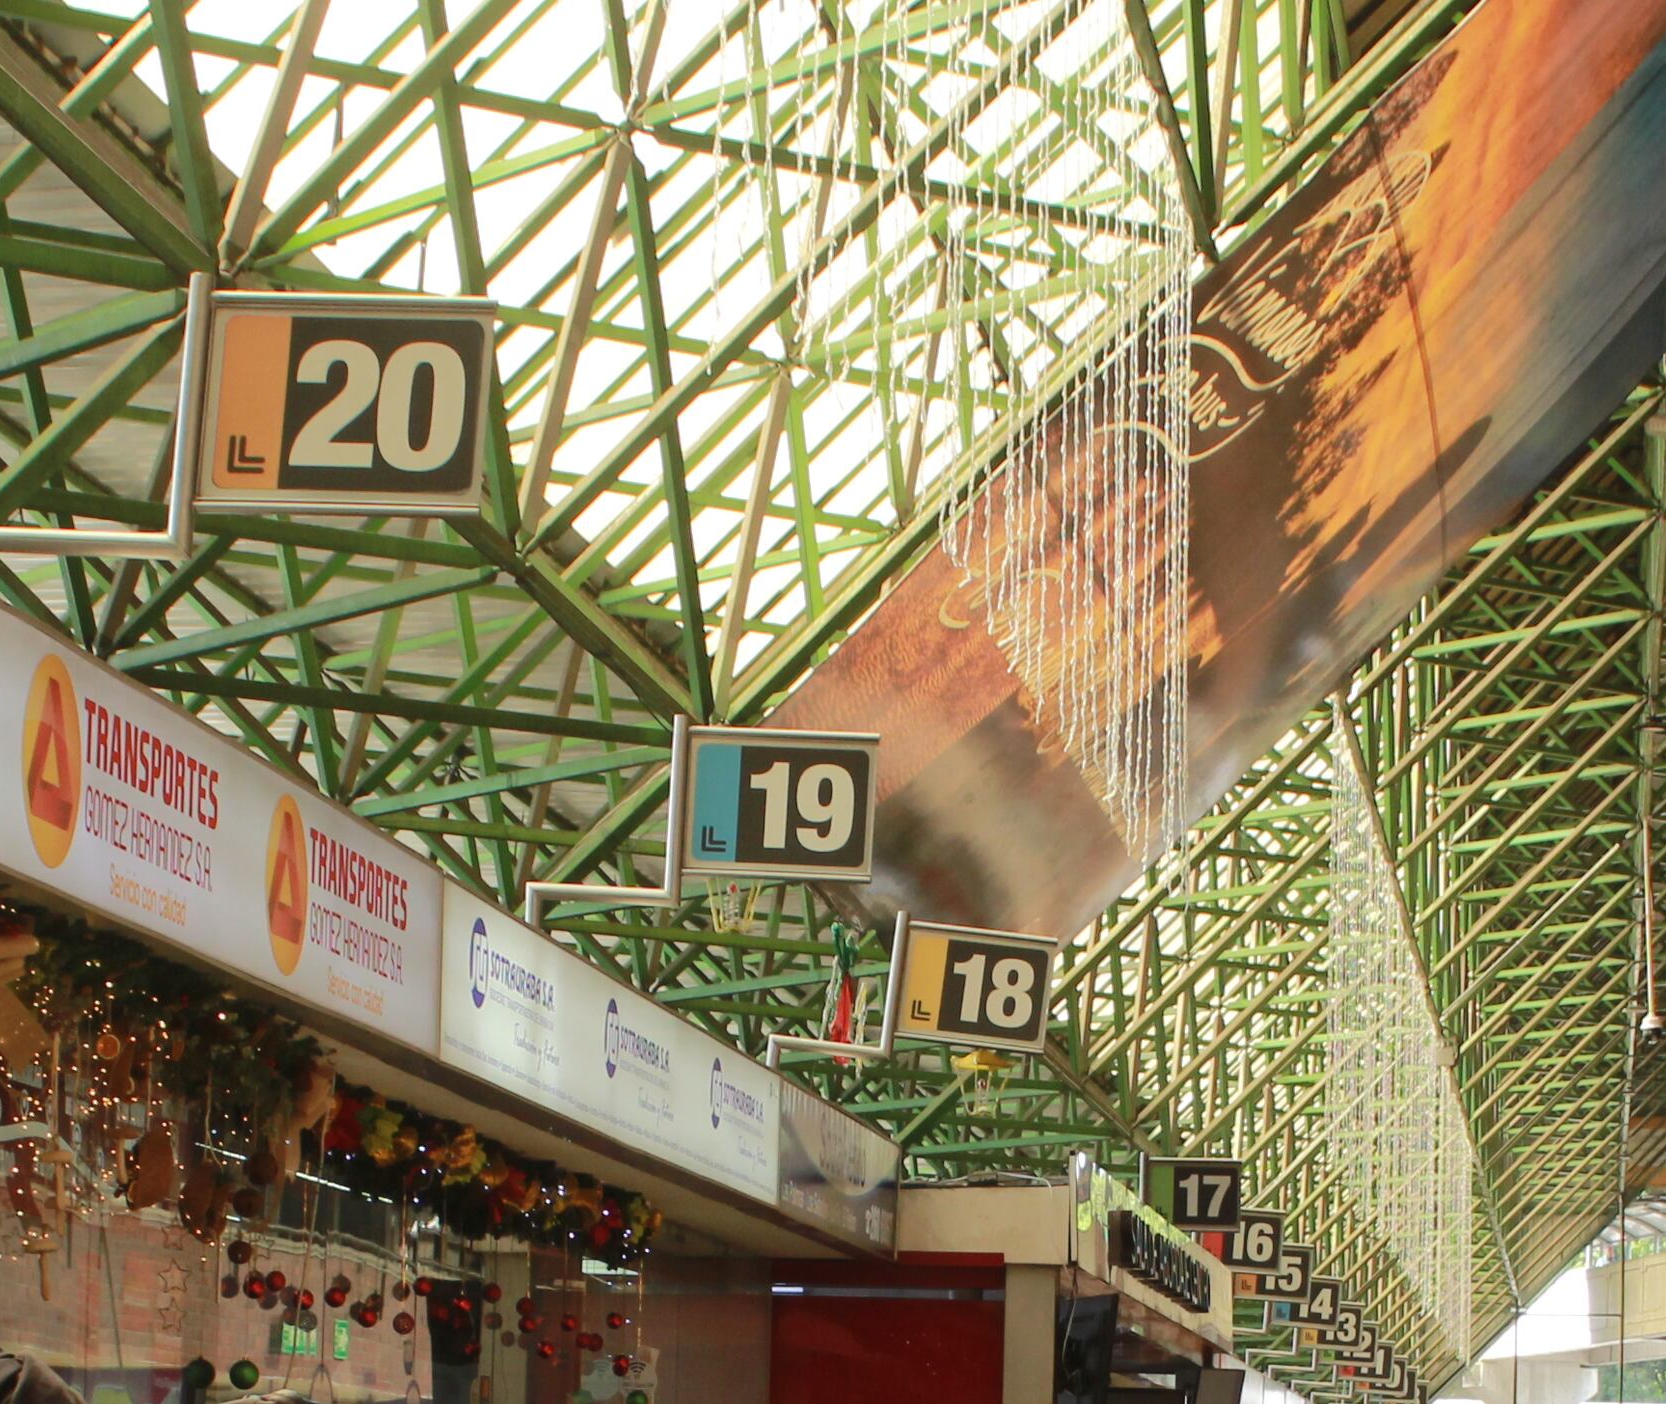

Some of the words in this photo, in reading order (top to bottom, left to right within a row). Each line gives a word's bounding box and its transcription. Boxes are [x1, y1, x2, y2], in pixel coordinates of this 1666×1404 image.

[289, 338, 467, 474] 20
[83, 696, 219, 831] TRANSPORTES
[85, 785, 127, 851] GOMEZ
[133, 811, 192, 885] HERNANDEZ
[750, 759, 857, 852] 19
[109, 862, 139, 903] Servicio
[141, 885, 158, 913] con
[159, 887, 187, 928] calidad
[309, 827, 409, 931] TRANSPORTES
[310, 901, 342, 956] GOMEZ
[953, 953, 1035, 1026] 18
[1178, 1174, 1232, 1218] 17
[1232, 1221, 1274, 1262] 16
[1325, 1312, 1357, 1342] 3
